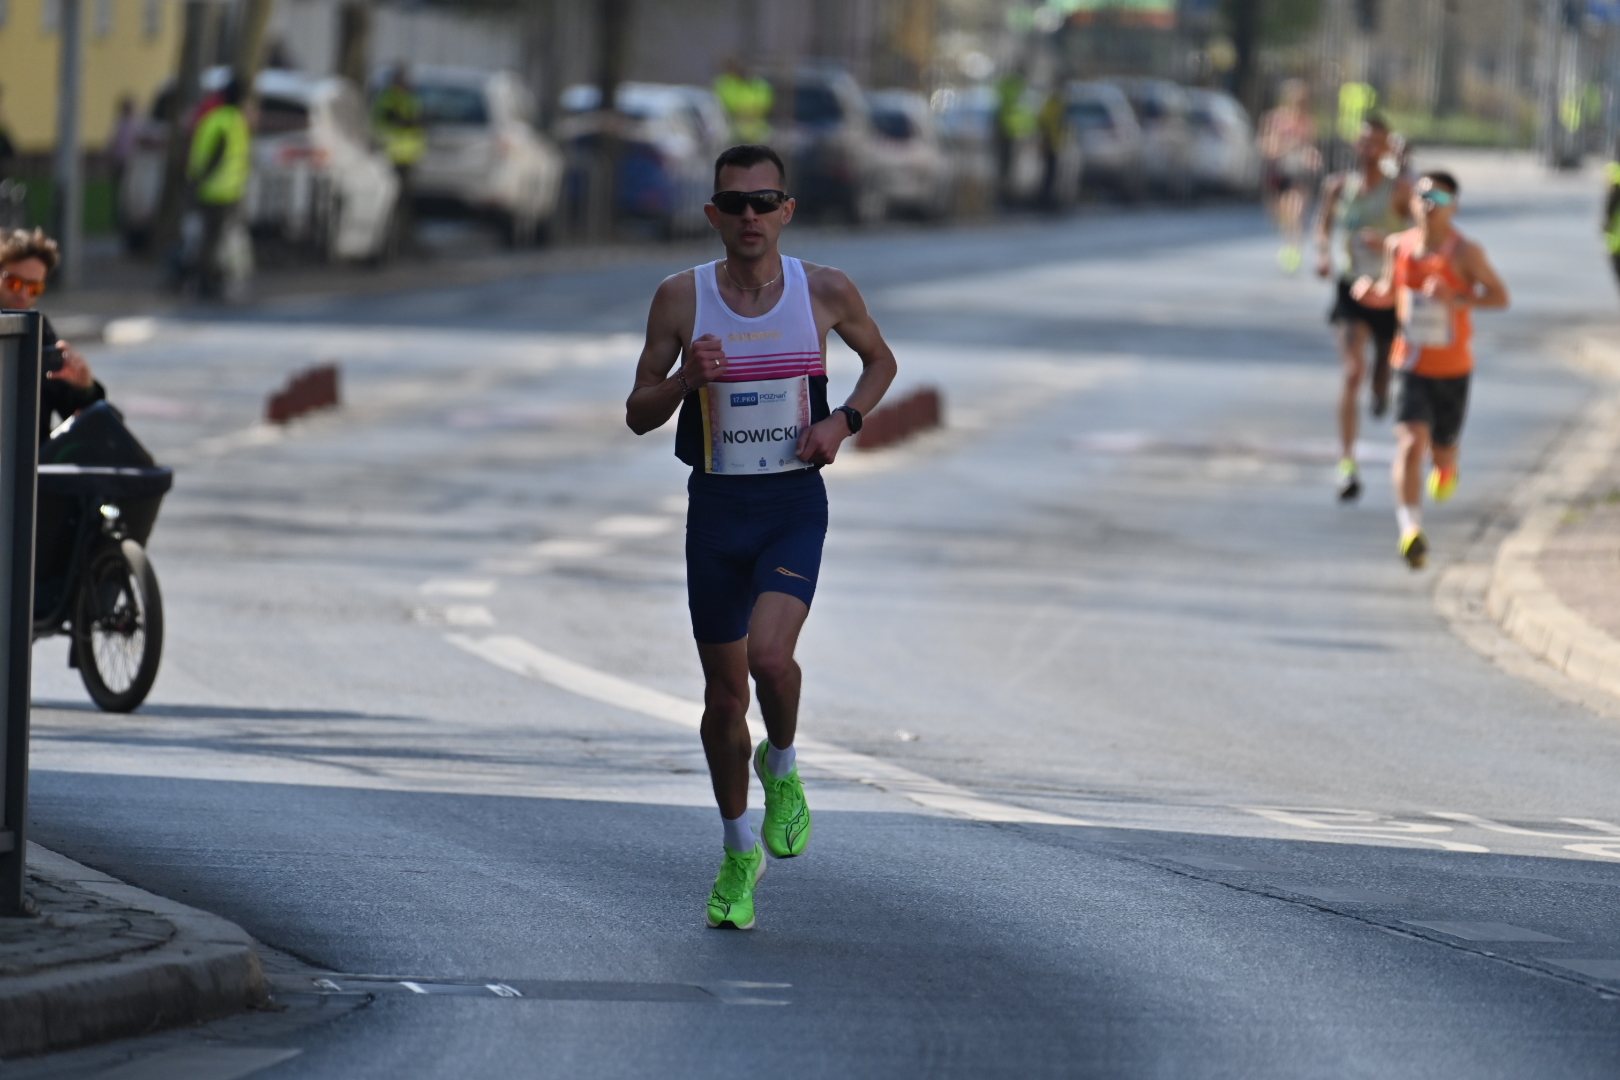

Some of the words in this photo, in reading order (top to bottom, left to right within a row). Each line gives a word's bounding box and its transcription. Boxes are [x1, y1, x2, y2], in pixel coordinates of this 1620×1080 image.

[728, 330, 781, 342] saucony
[732, 395, 756, 404] 17.PKO
[722, 425, 797, 444] NOWICKI
